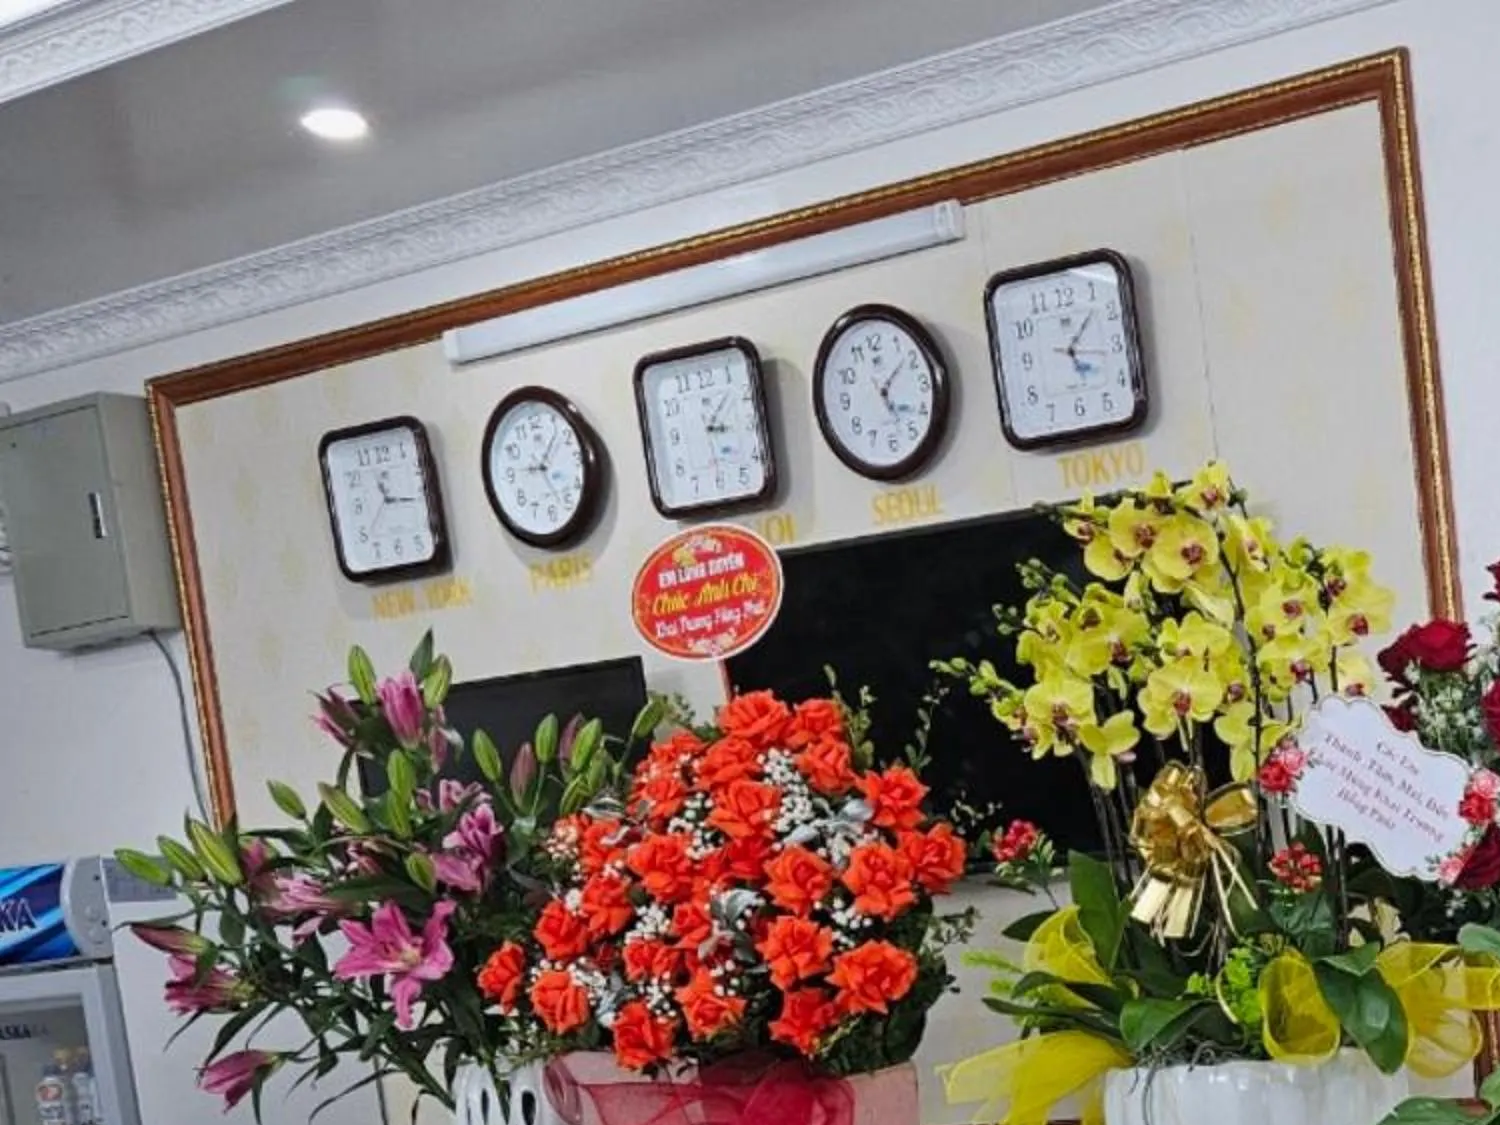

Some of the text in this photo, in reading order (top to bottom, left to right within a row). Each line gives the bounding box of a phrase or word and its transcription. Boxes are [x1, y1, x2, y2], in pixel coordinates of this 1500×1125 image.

[1054, 287, 1074, 308] 12
[1087, 281, 1097, 301] 1
[1030, 292, 1049, 315] 11
[1105, 302, 1119, 321] 2
[1015, 319, 1034, 340] 10
[865, 333, 881, 351] 12
[893, 336, 900, 352] 1
[1112, 335, 1122, 354] 3
[851, 346, 865, 363] 11
[907, 351, 919, 370] 2
[1022, 352, 1033, 371] 9
[838, 367, 856, 385] 10
[918, 374, 930, 392] 3
[1117, 368, 1126, 387] 4
[840, 392, 851, 411] 9
[1027, 385, 1039, 406] 8
[1102, 393, 1114, 412] 5
[919, 401, 929, 416] 4
[1045, 403, 1056, 423] 7
[1074, 397, 1086, 417] 6
[850, 415, 862, 436] 8
[907, 421, 918, 441] 5
[868, 430, 877, 448] 7
[888, 433, 898, 451] 6
[1057, 443, 1144, 488] TOKYO
[874, 485, 942, 524] SEOUL
